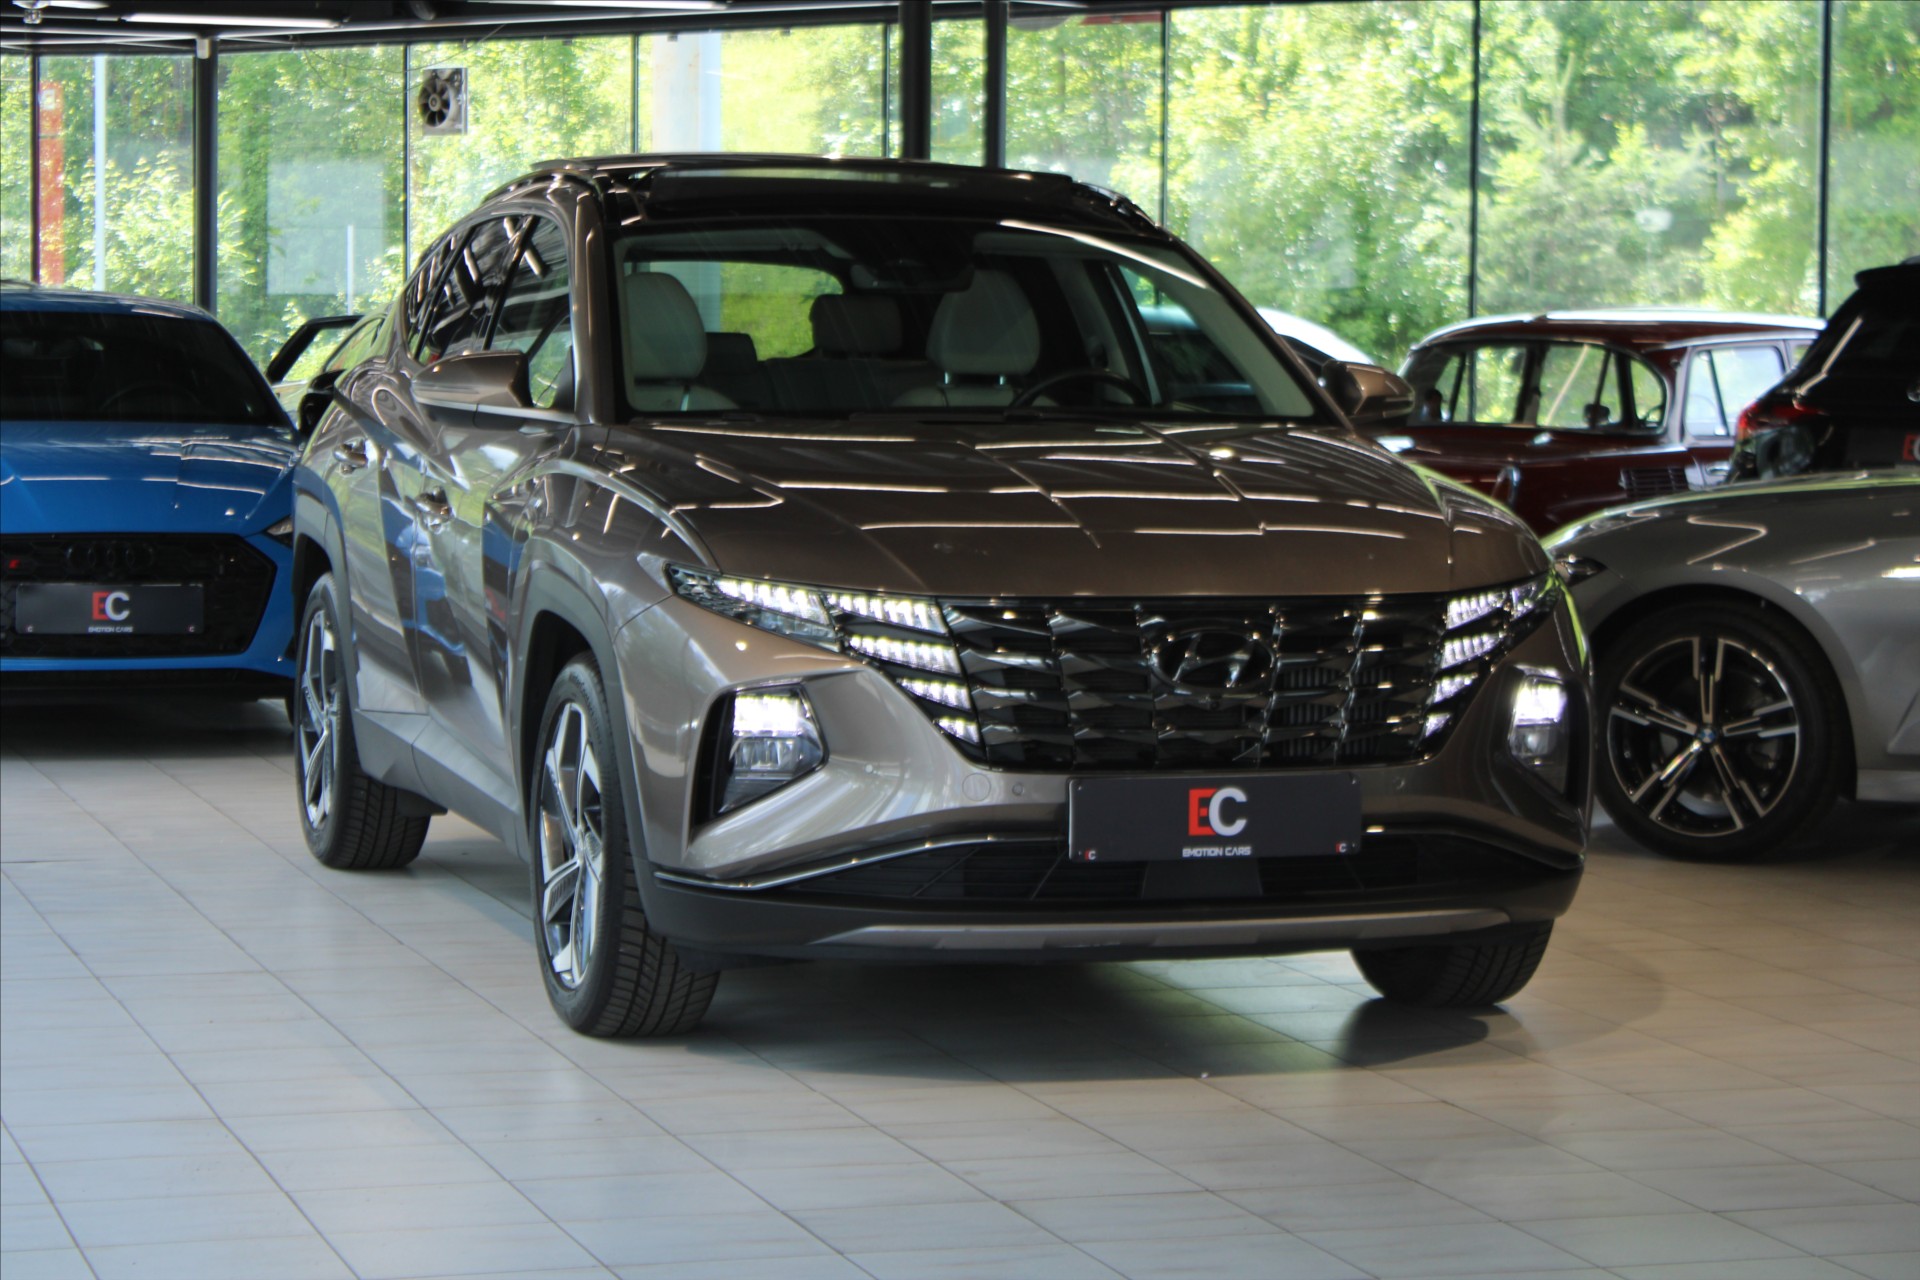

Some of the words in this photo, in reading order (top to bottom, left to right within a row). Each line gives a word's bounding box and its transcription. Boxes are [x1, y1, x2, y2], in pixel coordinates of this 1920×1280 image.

[92, 591, 130, 621] EC
[1188, 787, 1248, 837] EC
[1182, 847, 1223, 858] EMOTION
[1225, 846, 1252, 857] CARS
